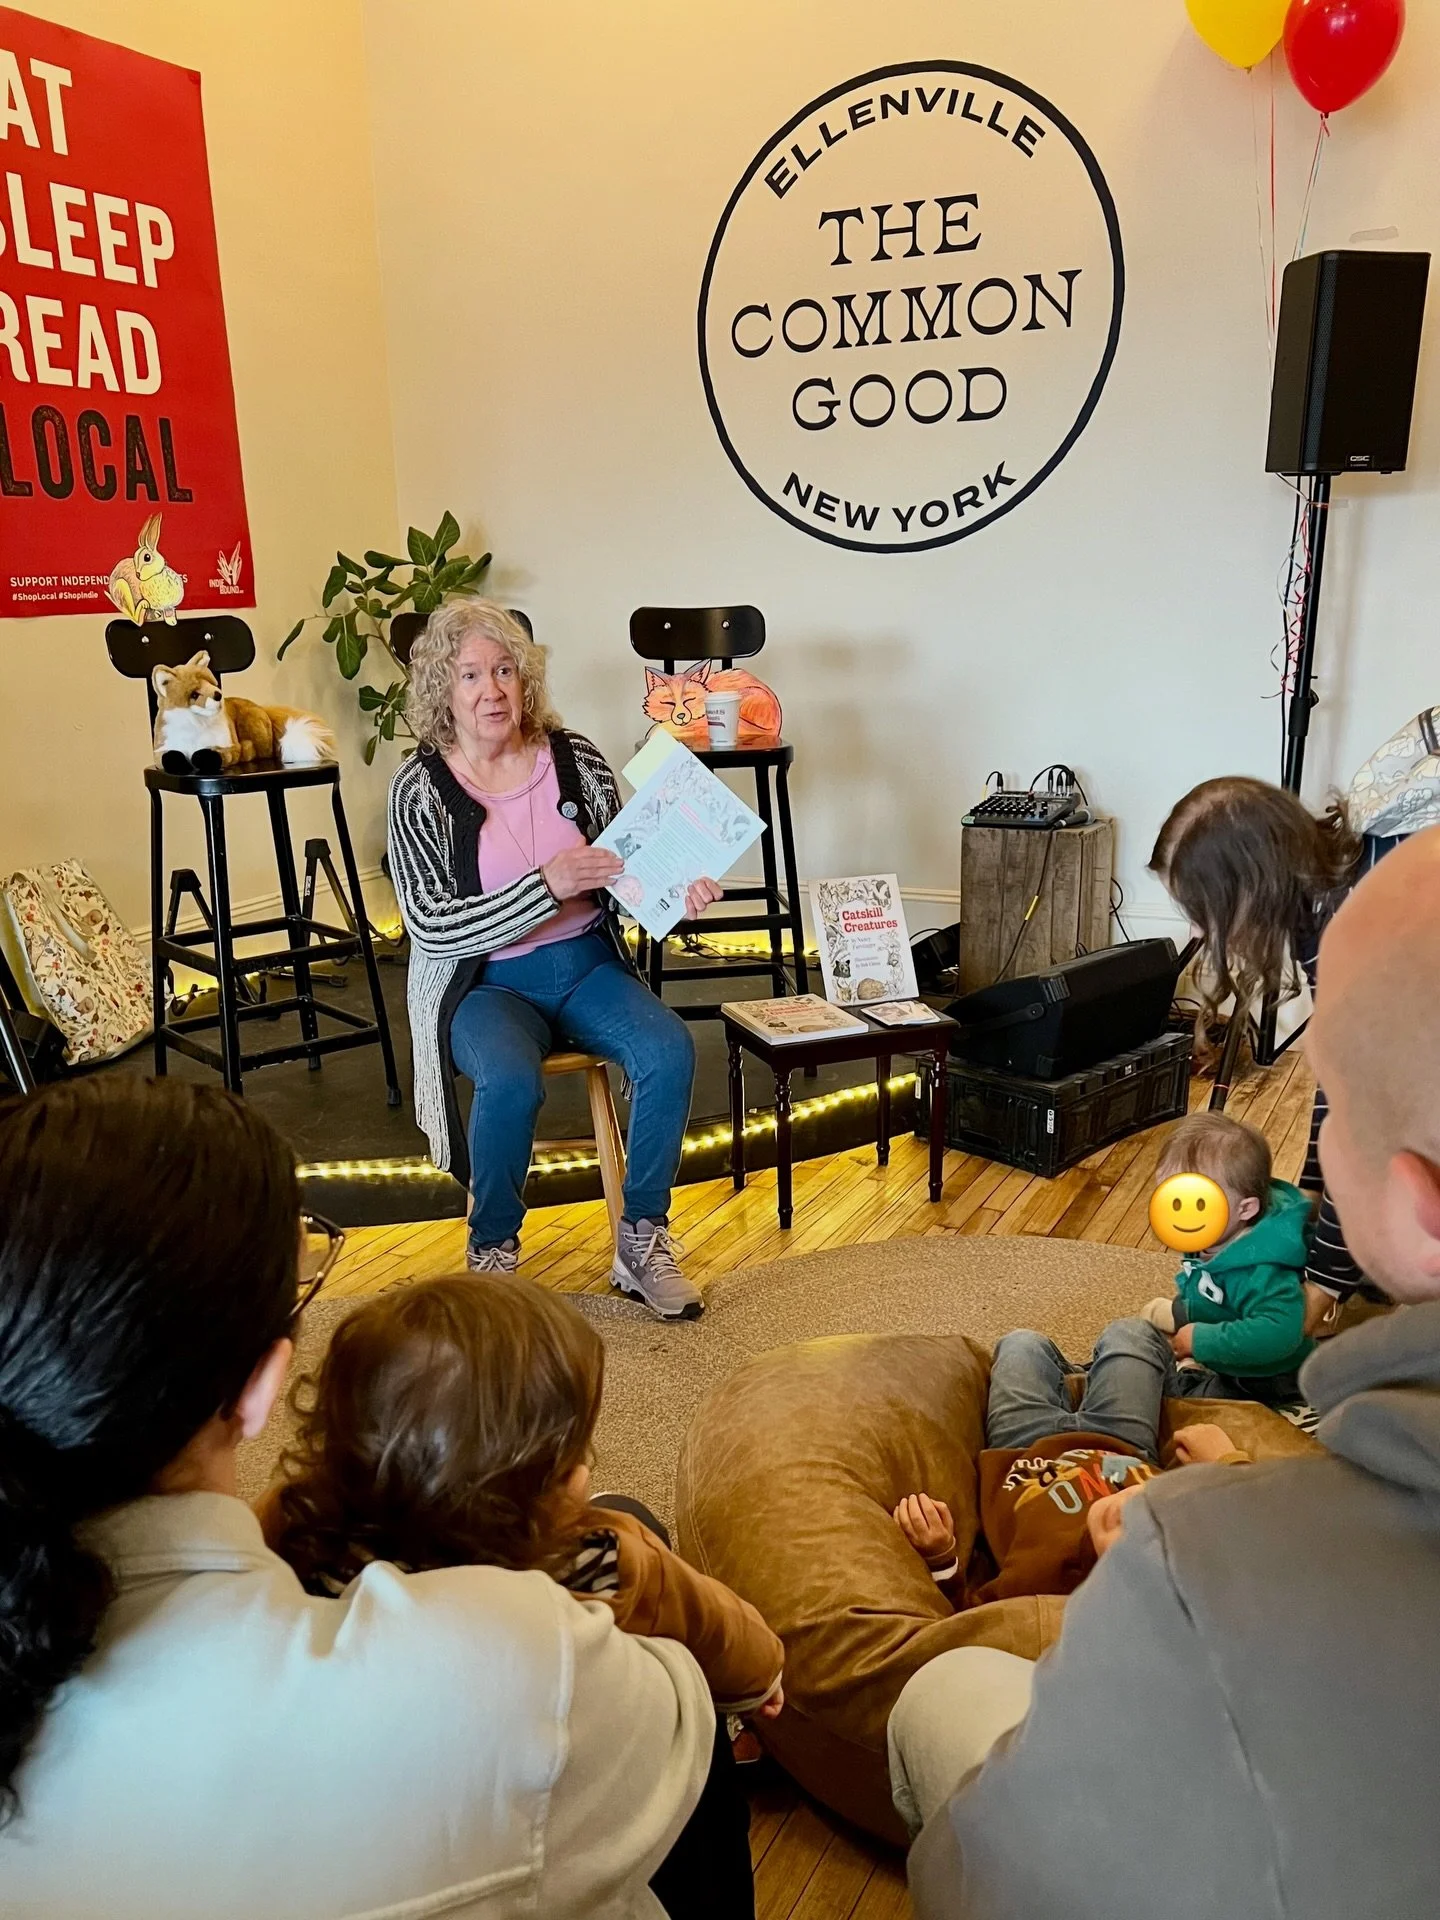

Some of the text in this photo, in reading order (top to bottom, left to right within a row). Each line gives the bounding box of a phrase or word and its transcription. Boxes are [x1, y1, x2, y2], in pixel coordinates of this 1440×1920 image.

[763, 87, 1047, 200] ELLENVILLE
[0, 171, 175, 289] LEEP
[818, 193, 982, 266] THE
[731, 269, 1083, 359] COMMON
[792, 367, 1008, 431] GOOD
[0, 402, 193, 503] LOCAL
[782, 460, 1018, 533] NEW YORK
[10, 576, 58, 587] SUPPORT
[12, 591, 99, 602] #ShopLocal #ShopIndie
[842, 907, 883, 921] Catskill
[844, 919, 899, 933] Creatures
